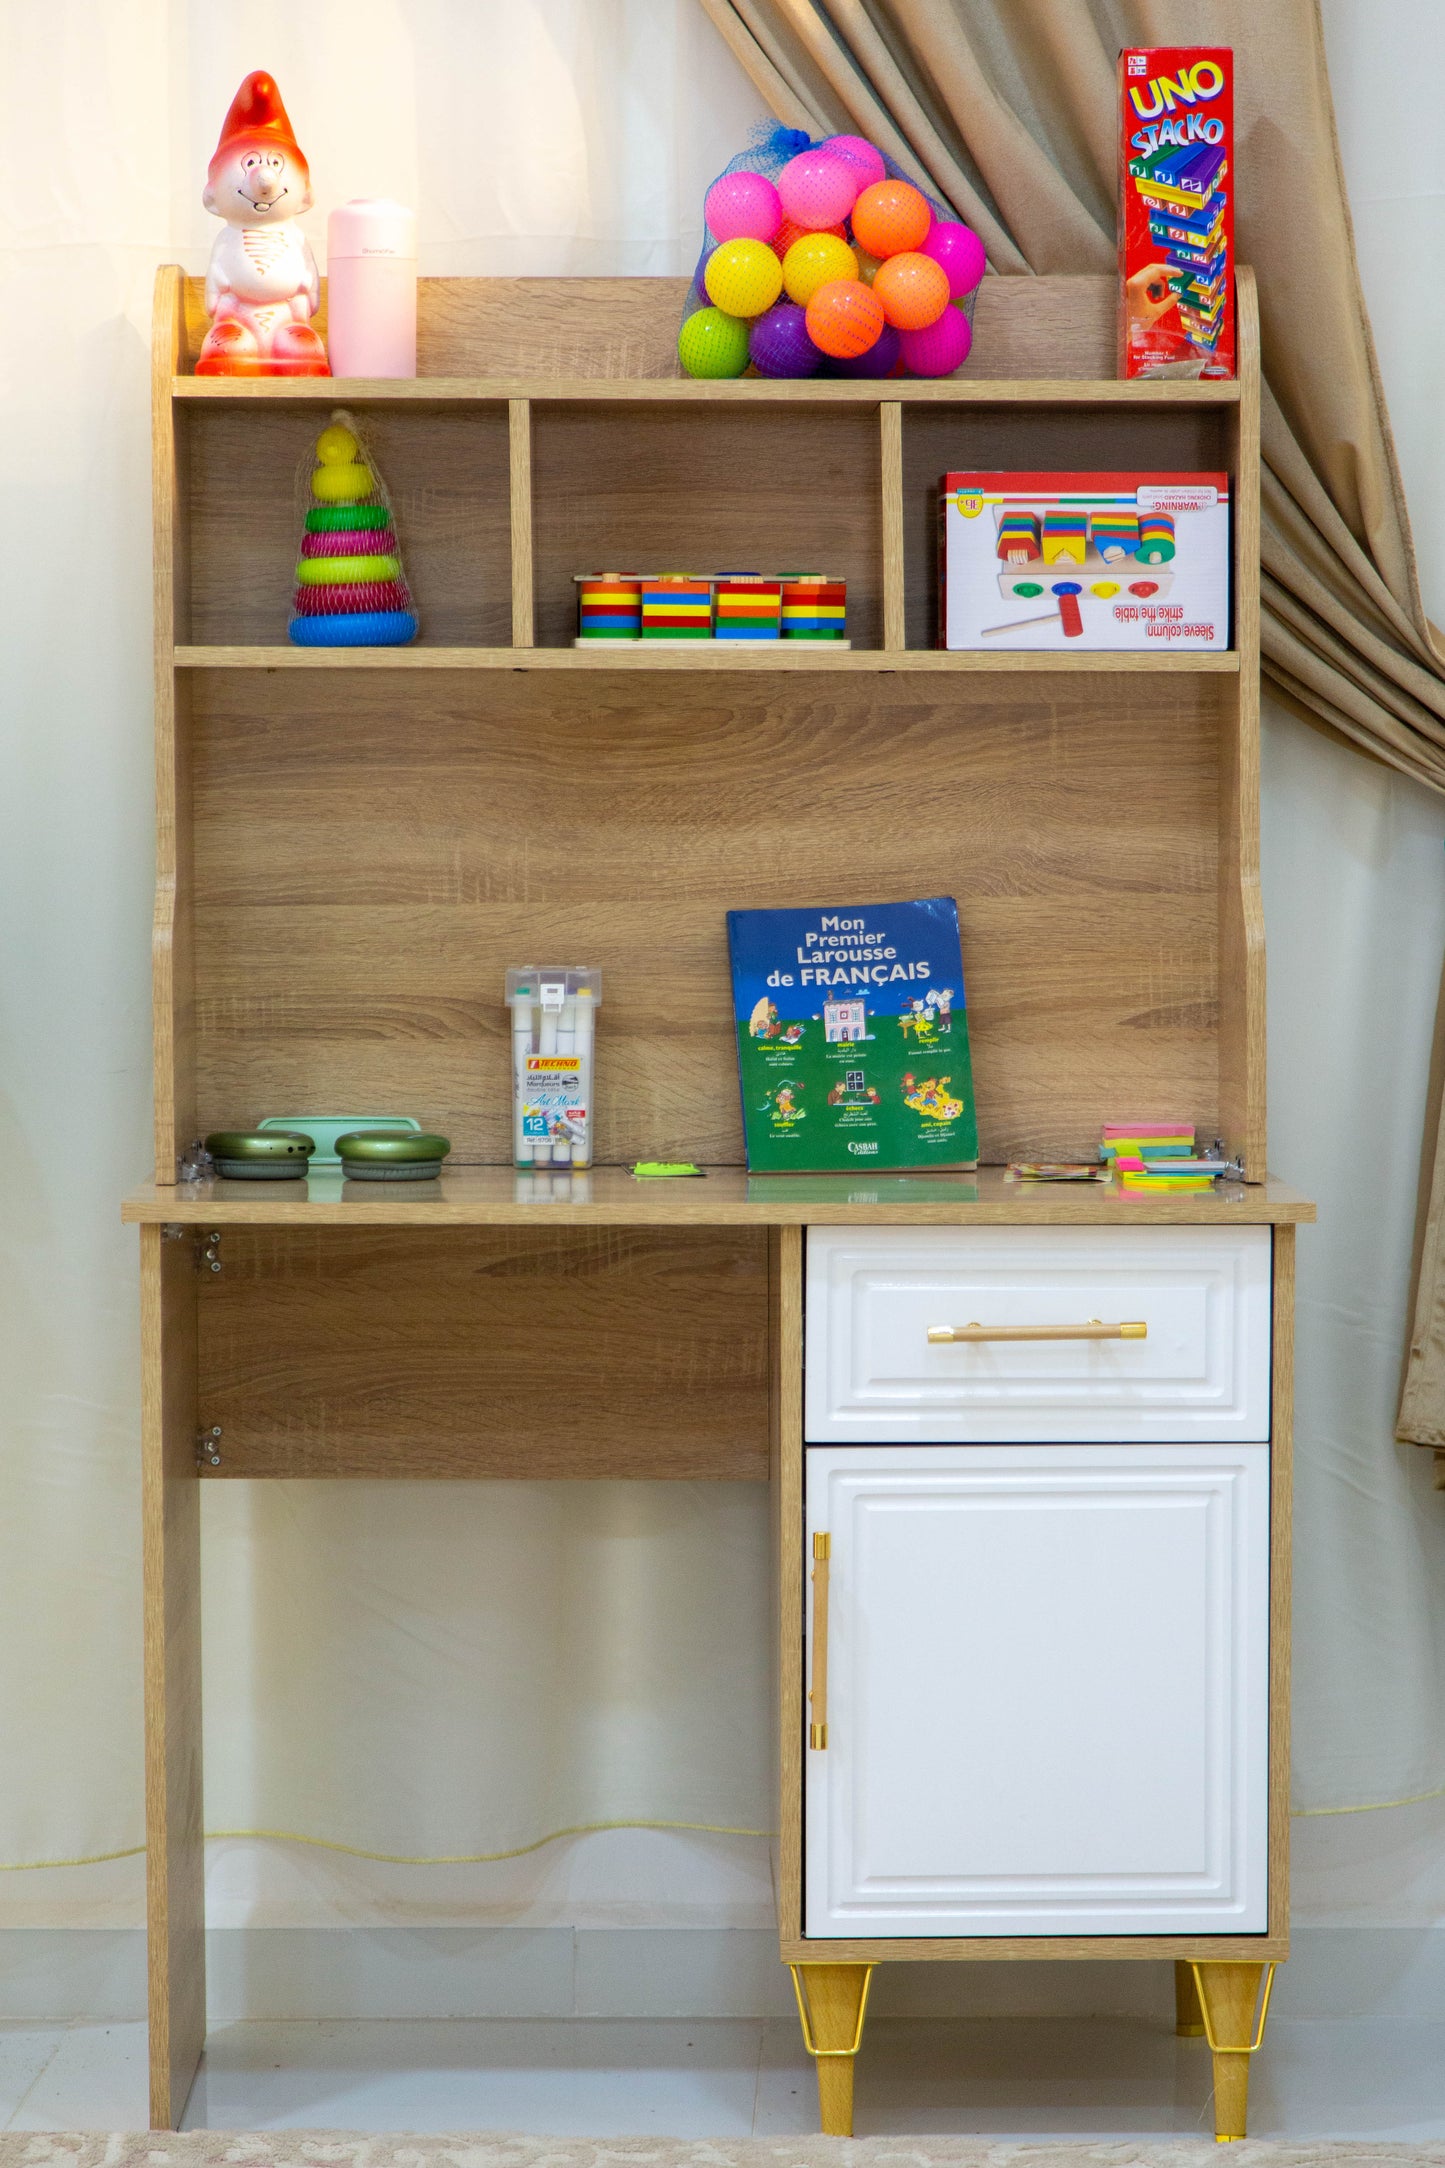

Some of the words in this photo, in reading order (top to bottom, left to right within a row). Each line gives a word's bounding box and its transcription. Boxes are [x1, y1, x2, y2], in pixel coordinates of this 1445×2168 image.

[1128, 60, 1224, 122] UNO
[1130, 113, 1224, 160] STACKO
[1152, 501, 1199, 511] WARNING:
[1115, 607, 1139, 623] table
[1141, 607, 1157, 623] the
[1158, 607, 1184, 623] strike
[1147, 625, 1182, 641] column
[1184, 625, 1214, 641] Sleeve
[821, 916, 865, 932] Mon
[805, 931, 886, 949] Premier
[796, 946, 897, 965] Larousse
[766, 970, 794, 987] de
[800, 961, 931, 987] FRANÇAIS
[540, 1059, 578, 1067] TECHNO
[526, 1118, 544, 1131] 12
[847, 1142, 878, 1153] CASBAH
